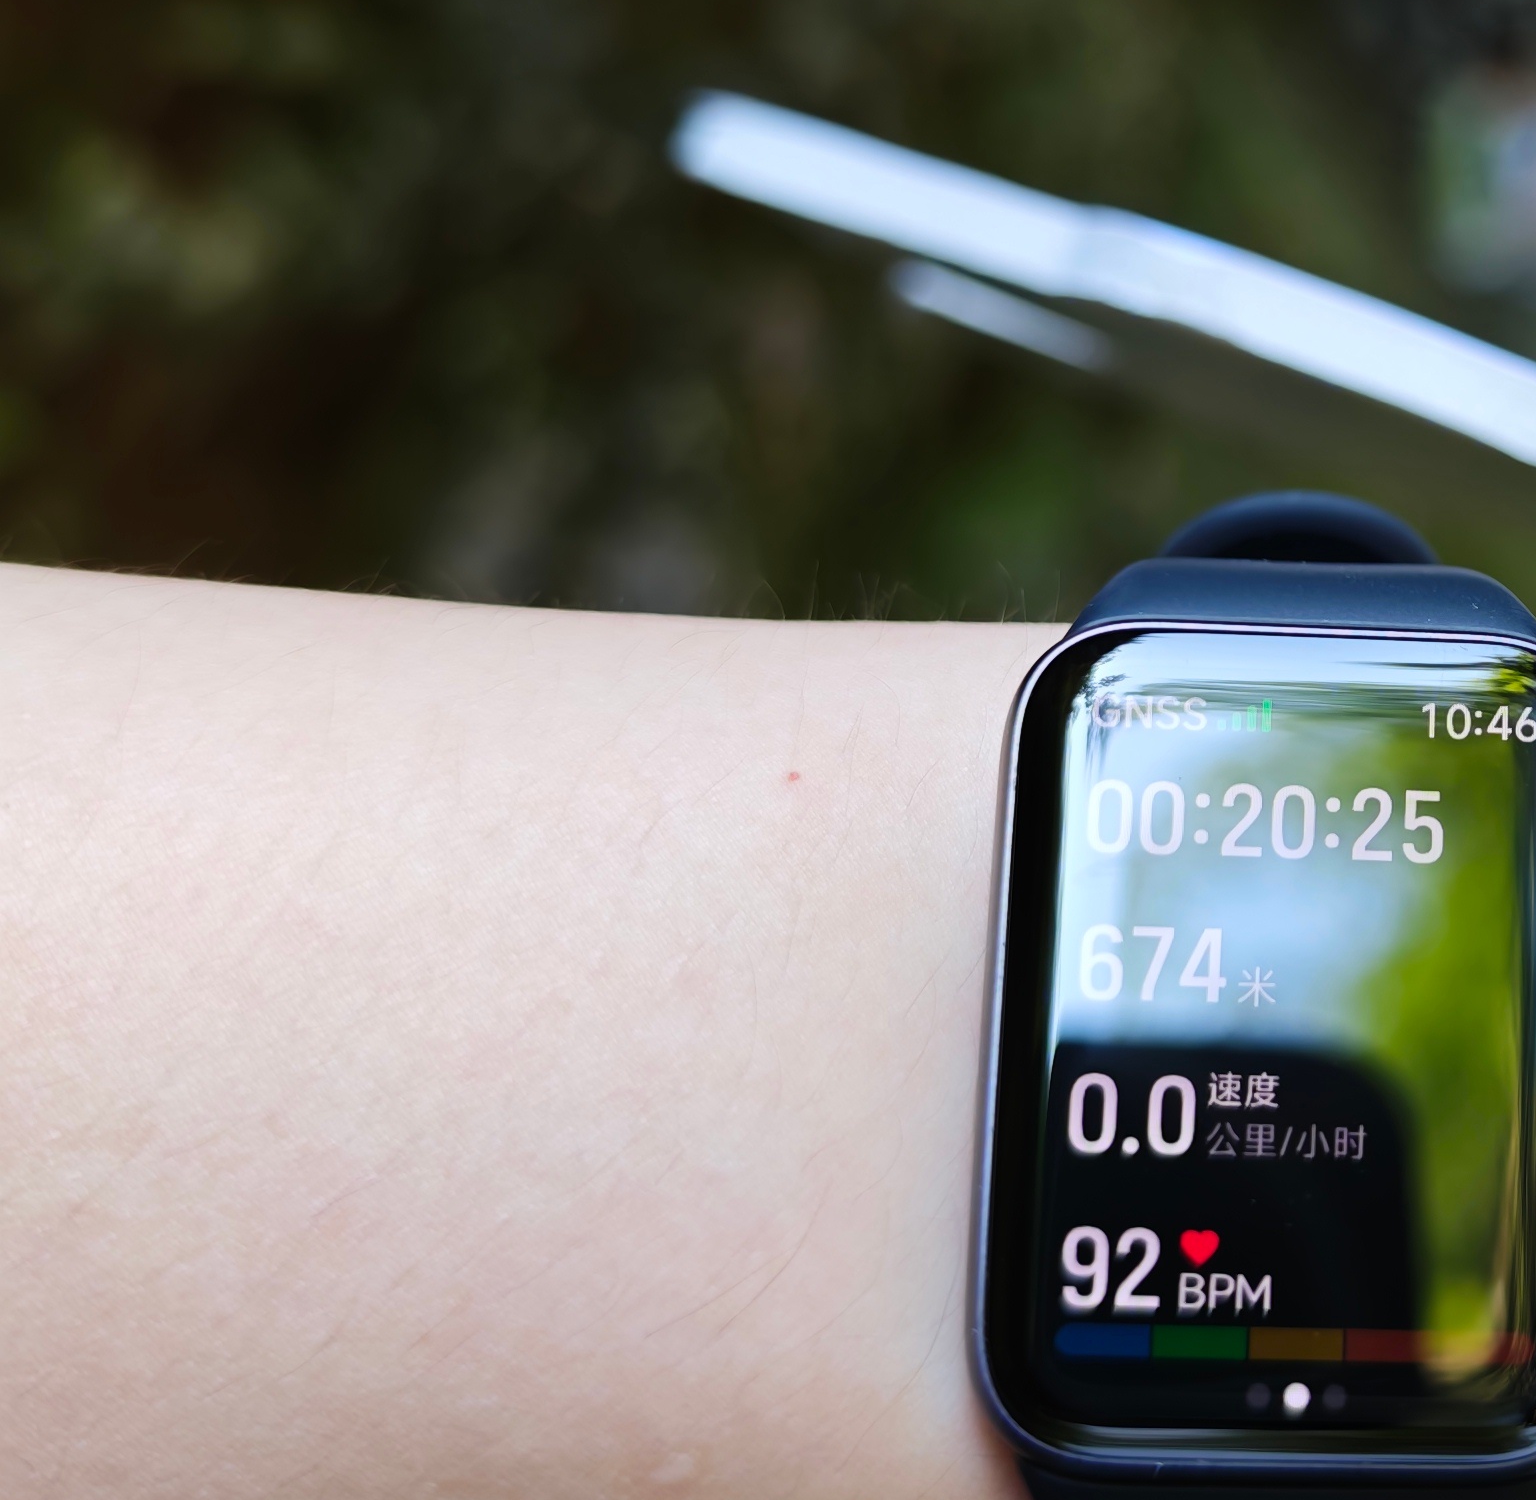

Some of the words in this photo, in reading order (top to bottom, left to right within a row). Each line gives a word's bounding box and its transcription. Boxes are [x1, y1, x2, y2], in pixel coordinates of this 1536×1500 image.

[1092, 694, 1208, 731] GNSS
[1085, 779, 1445, 864] 00:20:25
[1078, 923, 1228, 1004] 674
[1237, 966, 1277, 1008] 米
[1067, 1072, 1197, 1156] 0.0
[1207, 1071, 1280, 1108] 速度
[1206, 1121, 1367, 1159] 公里/小时
[1061, 1226, 1161, 1311] 92
[1178, 1272, 1272, 1312] BPM
